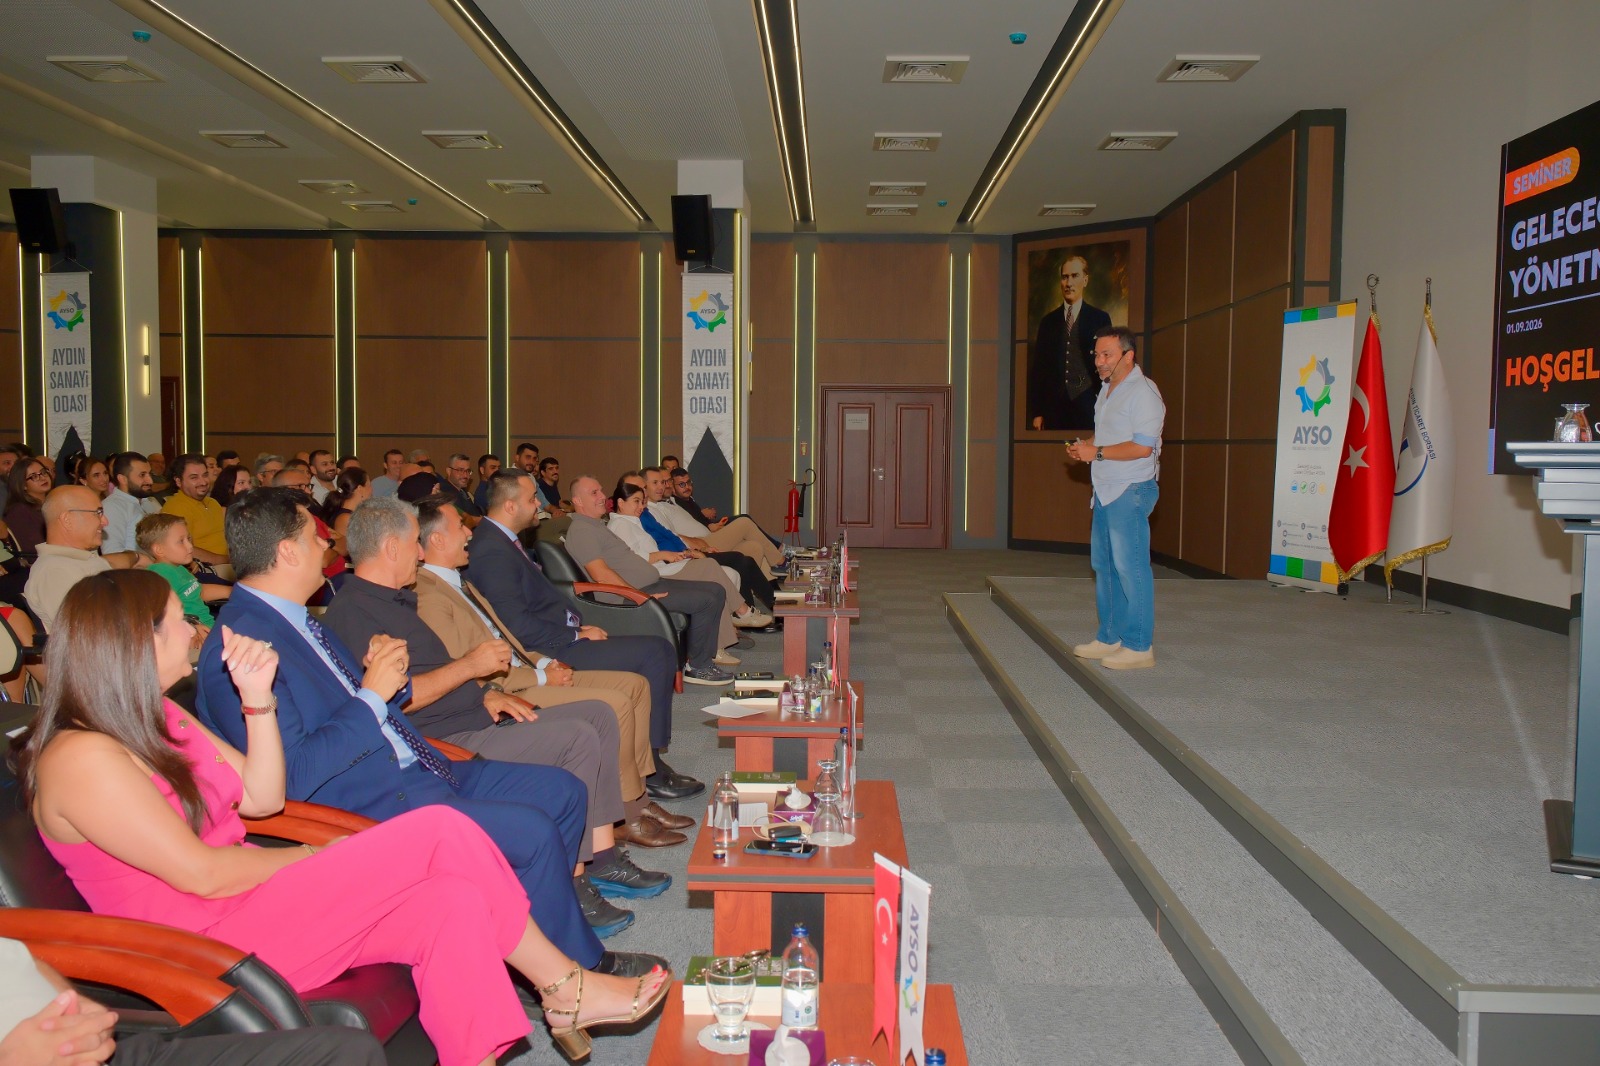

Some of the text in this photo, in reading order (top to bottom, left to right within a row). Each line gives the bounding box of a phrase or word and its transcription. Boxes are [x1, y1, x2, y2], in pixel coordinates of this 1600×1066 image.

[1513, 157, 1572, 195] SEMİNER
[1511, 196, 1600, 251] GELECE
[1506, 318, 1543, 334] 01.09.2026
[52, 347, 86, 366] AYDIN
[690, 348, 727, 367] AYDIN
[1506, 347, 1600, 393] HOŞGEL
[53, 394, 87, 413] ODASI
[689, 395, 727, 414] ODASI
[1292, 425, 1333, 446] AYSO
[1412, 405, 1426, 431] TİCARET
[1421, 431, 1437, 460] BORSASI
[907, 903, 920, 973] AYSO
